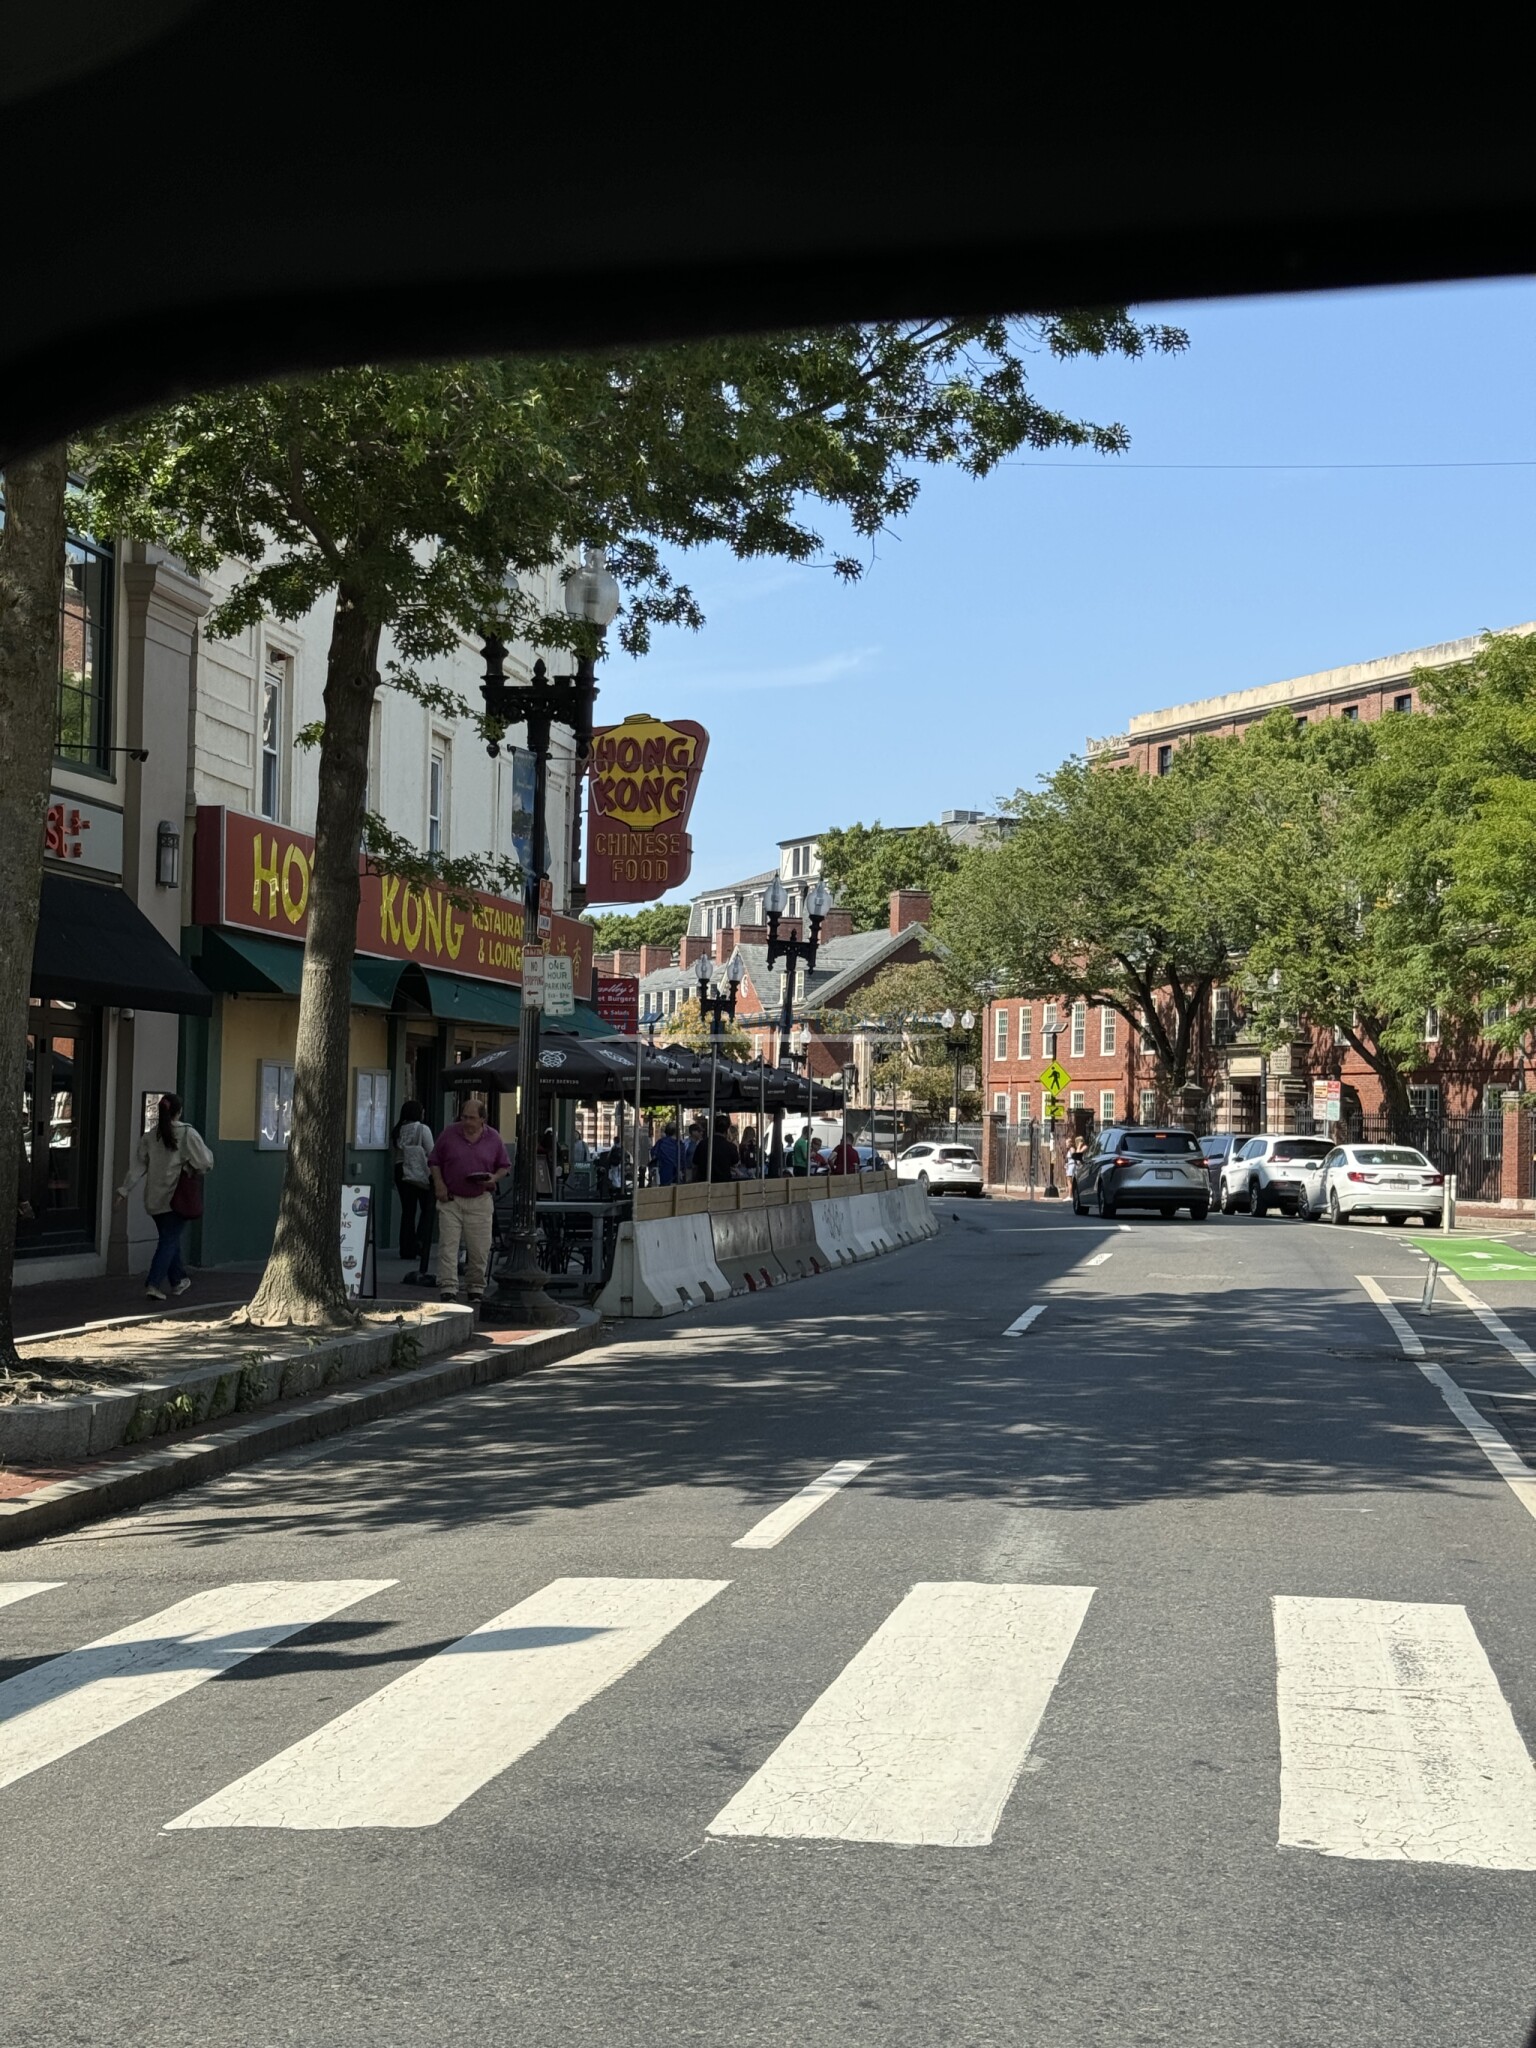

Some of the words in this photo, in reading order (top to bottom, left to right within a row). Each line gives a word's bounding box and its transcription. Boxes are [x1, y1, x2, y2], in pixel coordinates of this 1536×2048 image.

[596, 736, 690, 775] HONG
[593, 774, 688, 815] KONG
[595, 833, 680, 856] CHINESE
[611, 859, 669, 882] FOOD
[252, 832, 316, 926] HO
[380, 872, 466, 961] KONG
[478, 937, 485, 964] &
[489, 940, 524, 972] LOUNG
[548, 961, 566, 970] ONE
[545, 982, 572, 991] PARKING
[547, 971, 568, 980] HOUR
[607, 995, 636, 1003] Burgers
